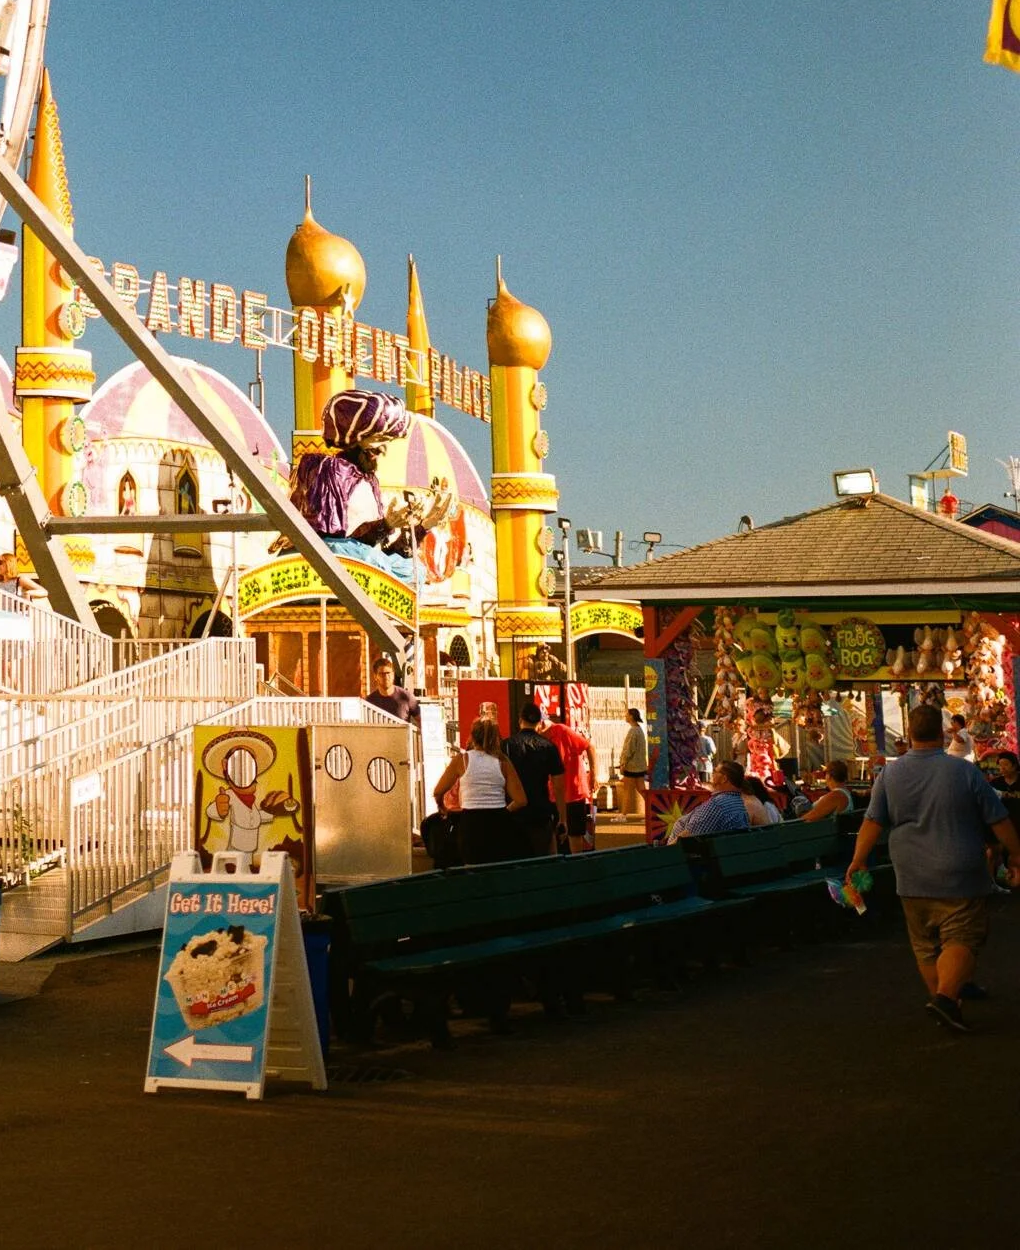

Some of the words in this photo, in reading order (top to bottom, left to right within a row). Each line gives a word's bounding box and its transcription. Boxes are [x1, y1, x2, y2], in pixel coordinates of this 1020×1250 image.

[299, 306, 410, 388] ORIENT
[429, 346, 492, 424] PALACE
[837, 629, 876, 648] FROG
[841, 649, 873, 667] BOG
[170, 892, 201, 913] Get
[204, 893, 223, 913] It
[226, 893, 276, 914] Here!
